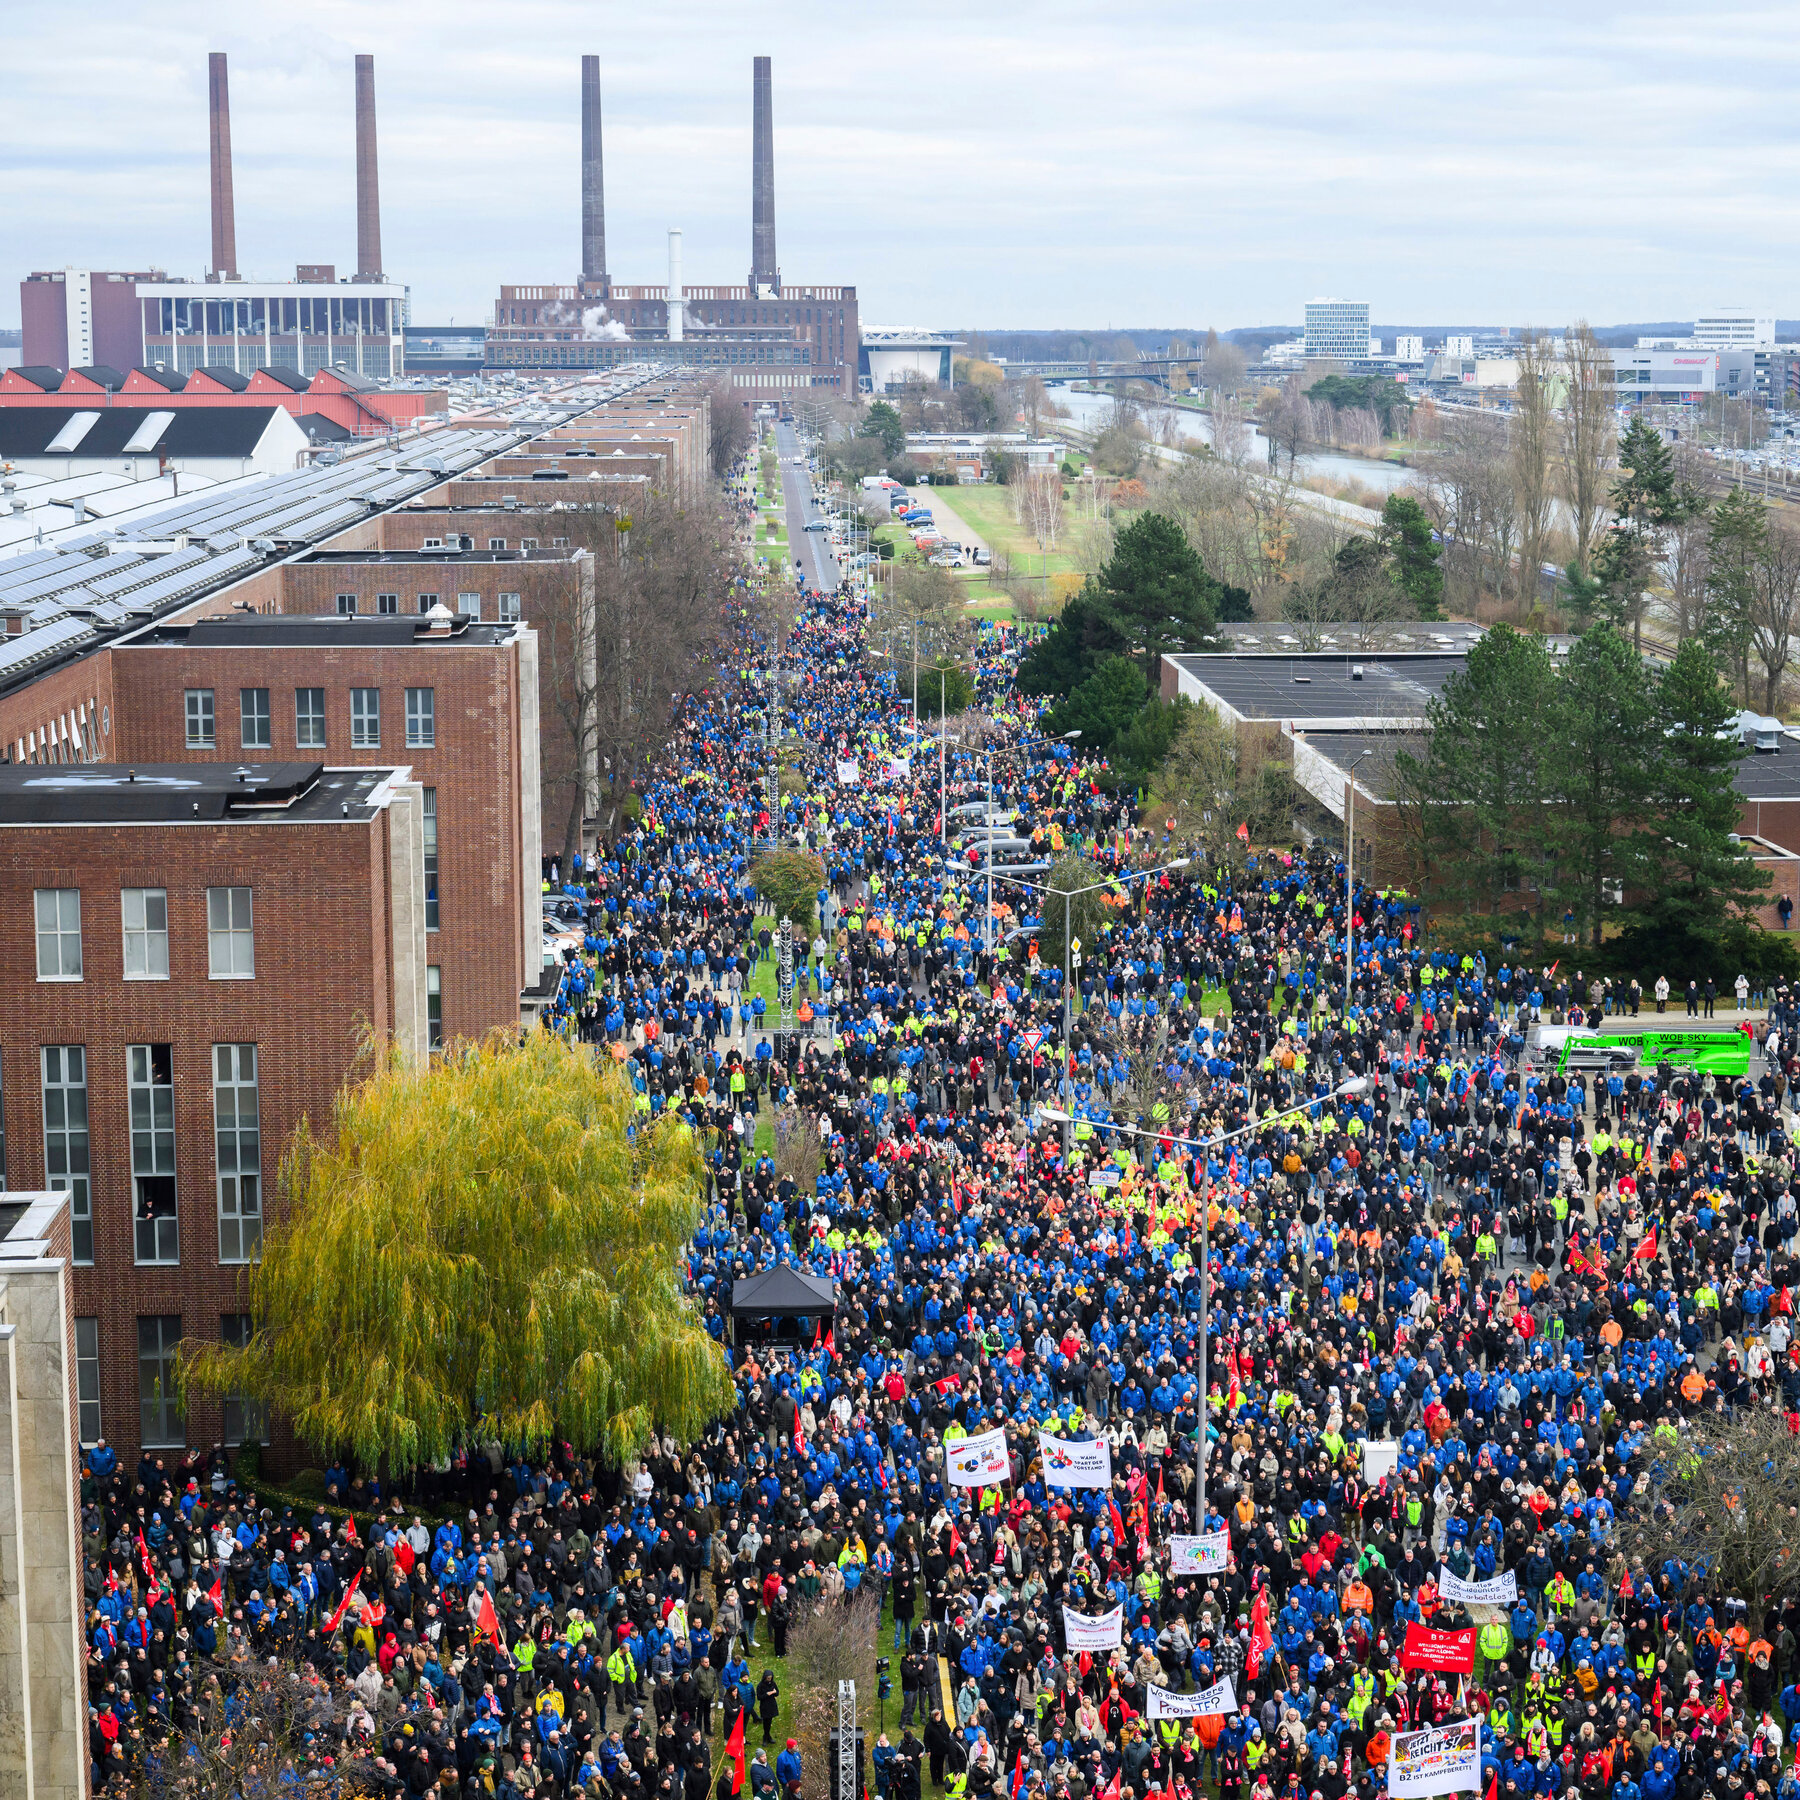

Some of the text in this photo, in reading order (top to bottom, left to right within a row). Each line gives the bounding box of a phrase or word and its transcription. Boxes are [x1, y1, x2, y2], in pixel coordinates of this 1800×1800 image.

[1150, 1687, 1163, 1698] Wo
[1409, 1733, 1430, 1750] JETZT
[1424, 1765, 1472, 1778] KAMPFBEREIT!
